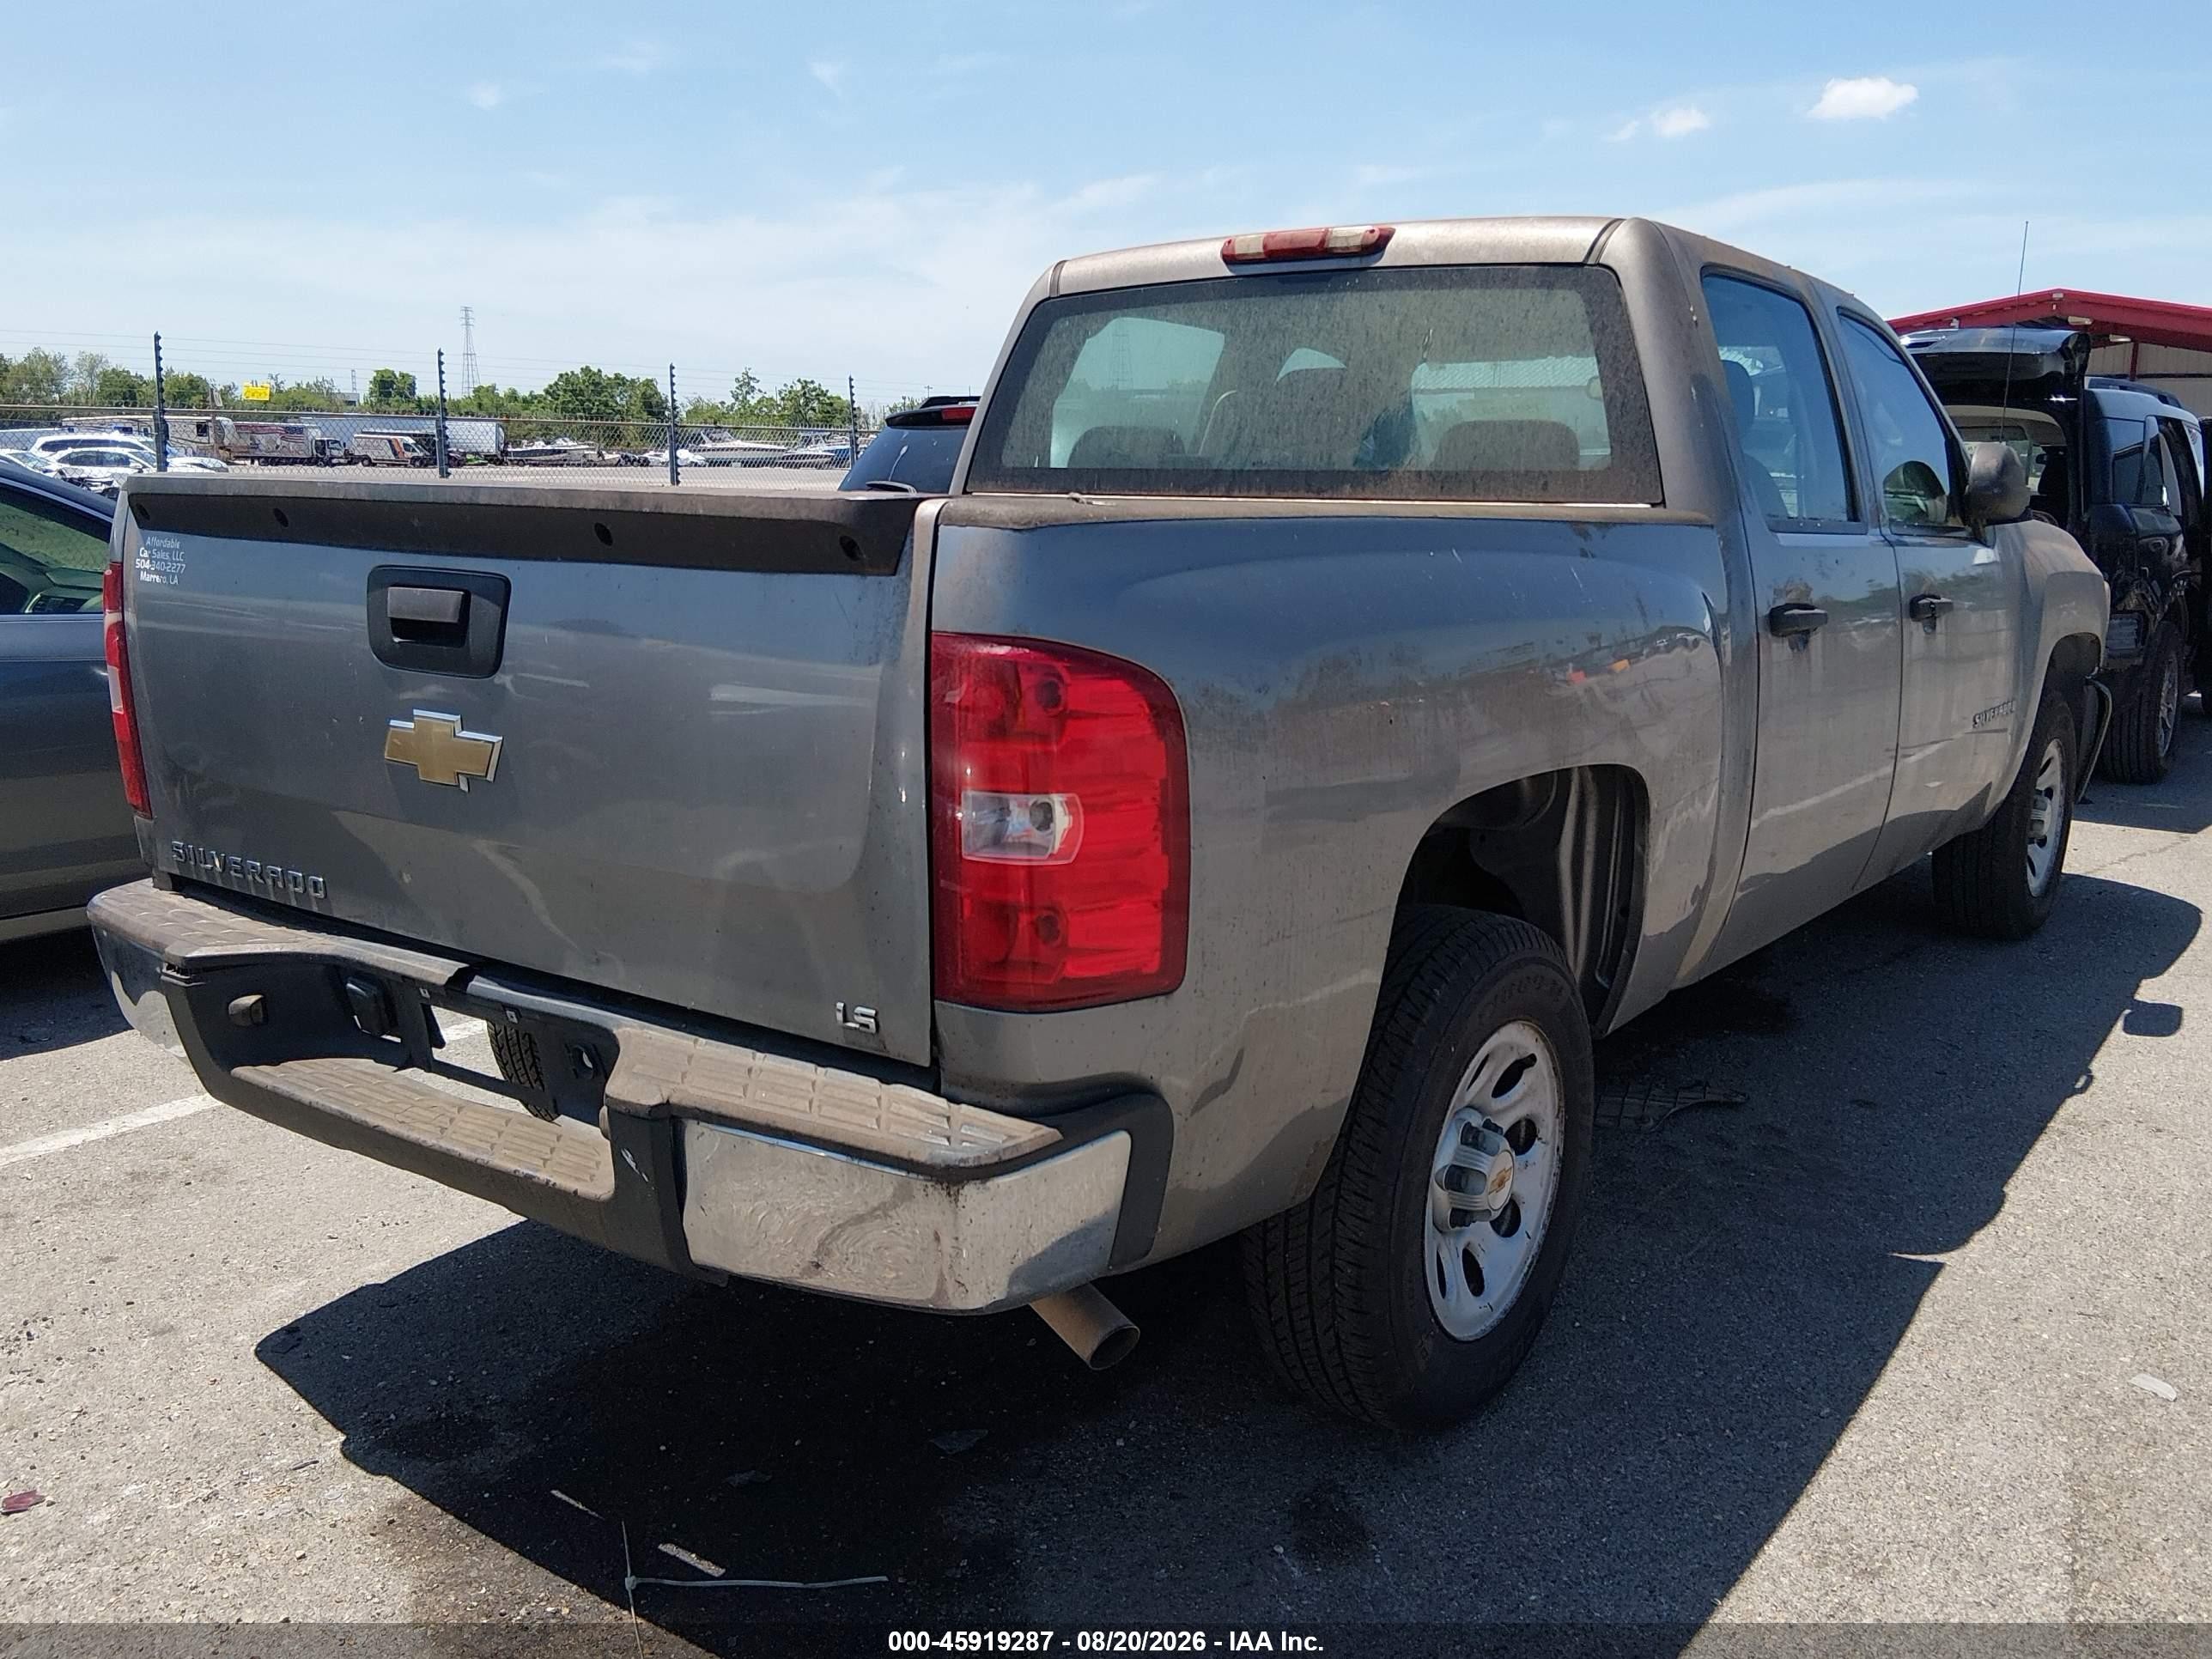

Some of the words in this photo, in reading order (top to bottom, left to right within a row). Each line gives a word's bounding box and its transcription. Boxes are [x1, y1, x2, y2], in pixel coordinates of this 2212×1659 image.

[146, 536, 180, 549] Affordable
[139, 547, 151, 558] Car
[172, 550, 185, 562] LLC
[136, 558, 186, 574] 504-340-2277
[169, 574, 179, 585] LA
[172, 841, 327, 899] SILVERADO
[836, 1001, 877, 1034] LS
